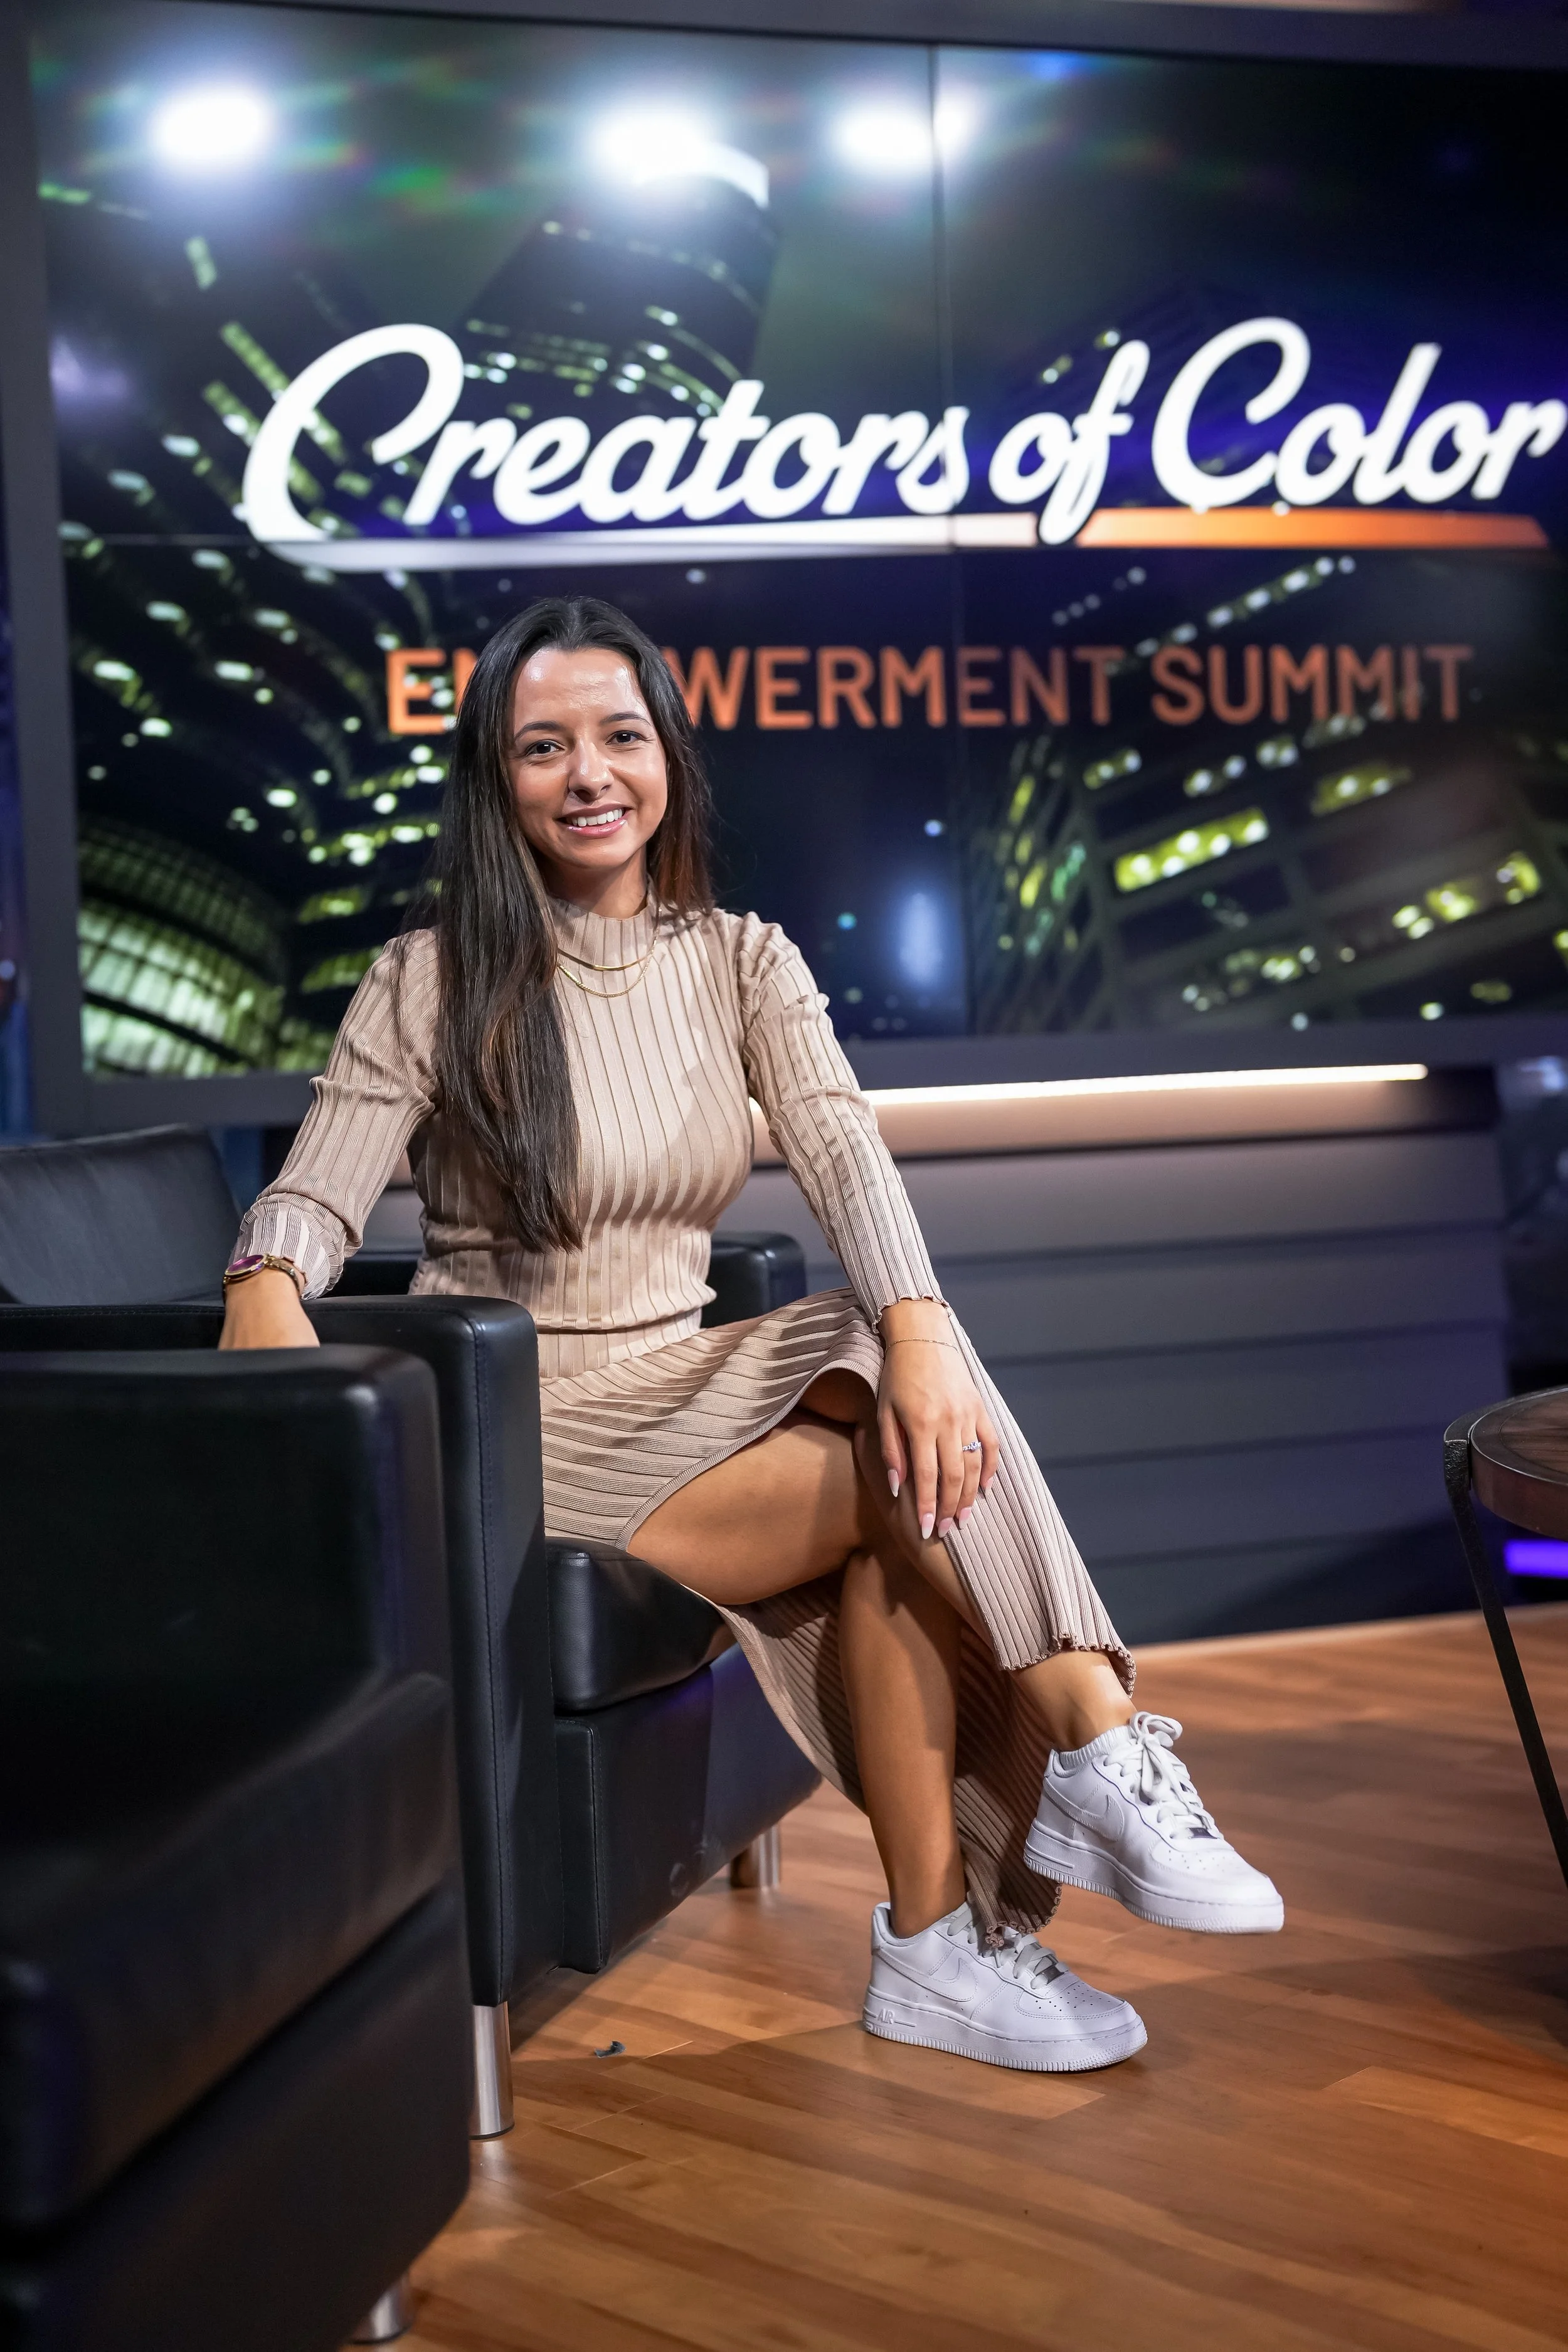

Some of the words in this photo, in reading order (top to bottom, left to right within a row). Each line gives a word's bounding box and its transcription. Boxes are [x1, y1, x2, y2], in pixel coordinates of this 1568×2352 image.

[242, 323, 969, 543] Creators
[988, 339, 1150, 544] of
[1152, 317, 1567, 506] Color
[386, 647, 1126, 734] EWERMENT
[1151, 645, 1472, 725] SUMMIT
